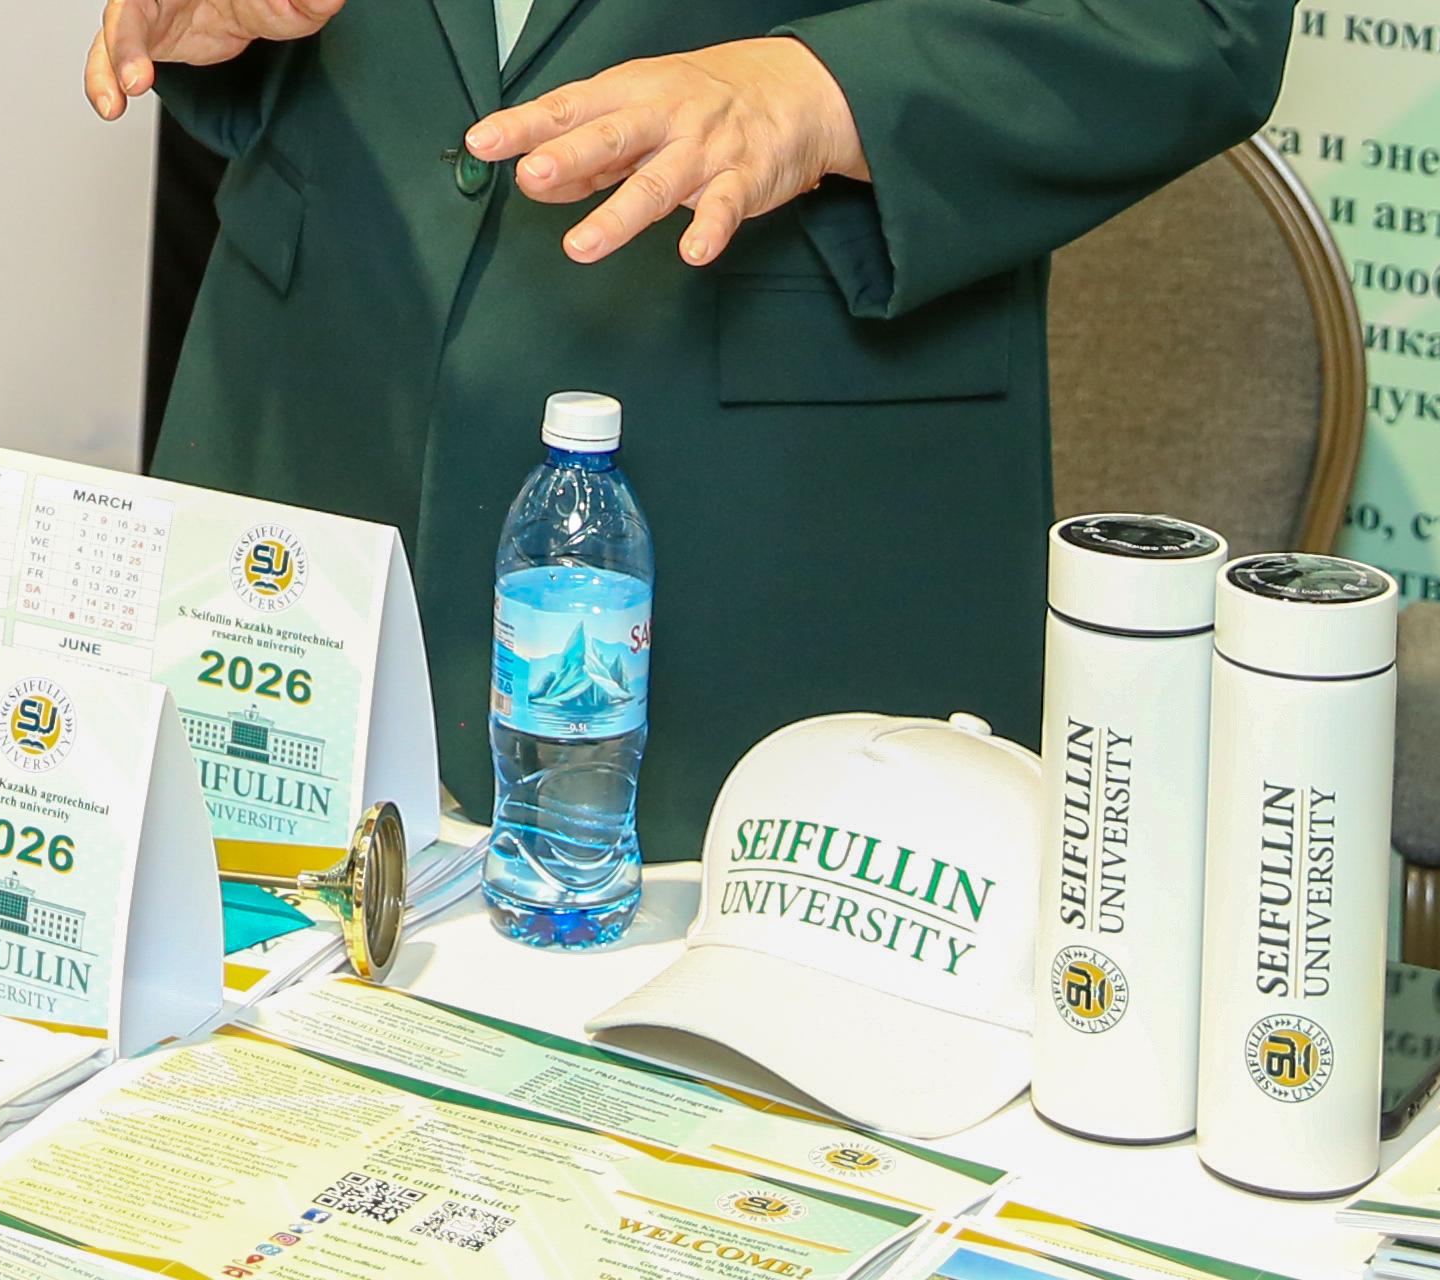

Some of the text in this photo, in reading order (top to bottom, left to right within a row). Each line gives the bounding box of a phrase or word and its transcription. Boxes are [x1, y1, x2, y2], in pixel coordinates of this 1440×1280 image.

[73, 489, 133, 512] MARCH
[197, 649, 313, 706] 2026
[20, 799, 75, 823] university
[40, 789, 109, 819] agrotechnical
[1059, 715, 1100, 931] SEIFULLIN
[1097, 726, 1134, 935] UNIVERSITY
[730, 817, 996, 924] SEIFULLIN
[1254, 780, 1297, 998] SEIFULLIN
[1304, 787, 1337, 1000] UNIVERSITY
[720, 881, 977, 978] UNIVERSITY
[618, 1215, 814, 1280] WELCOME!
